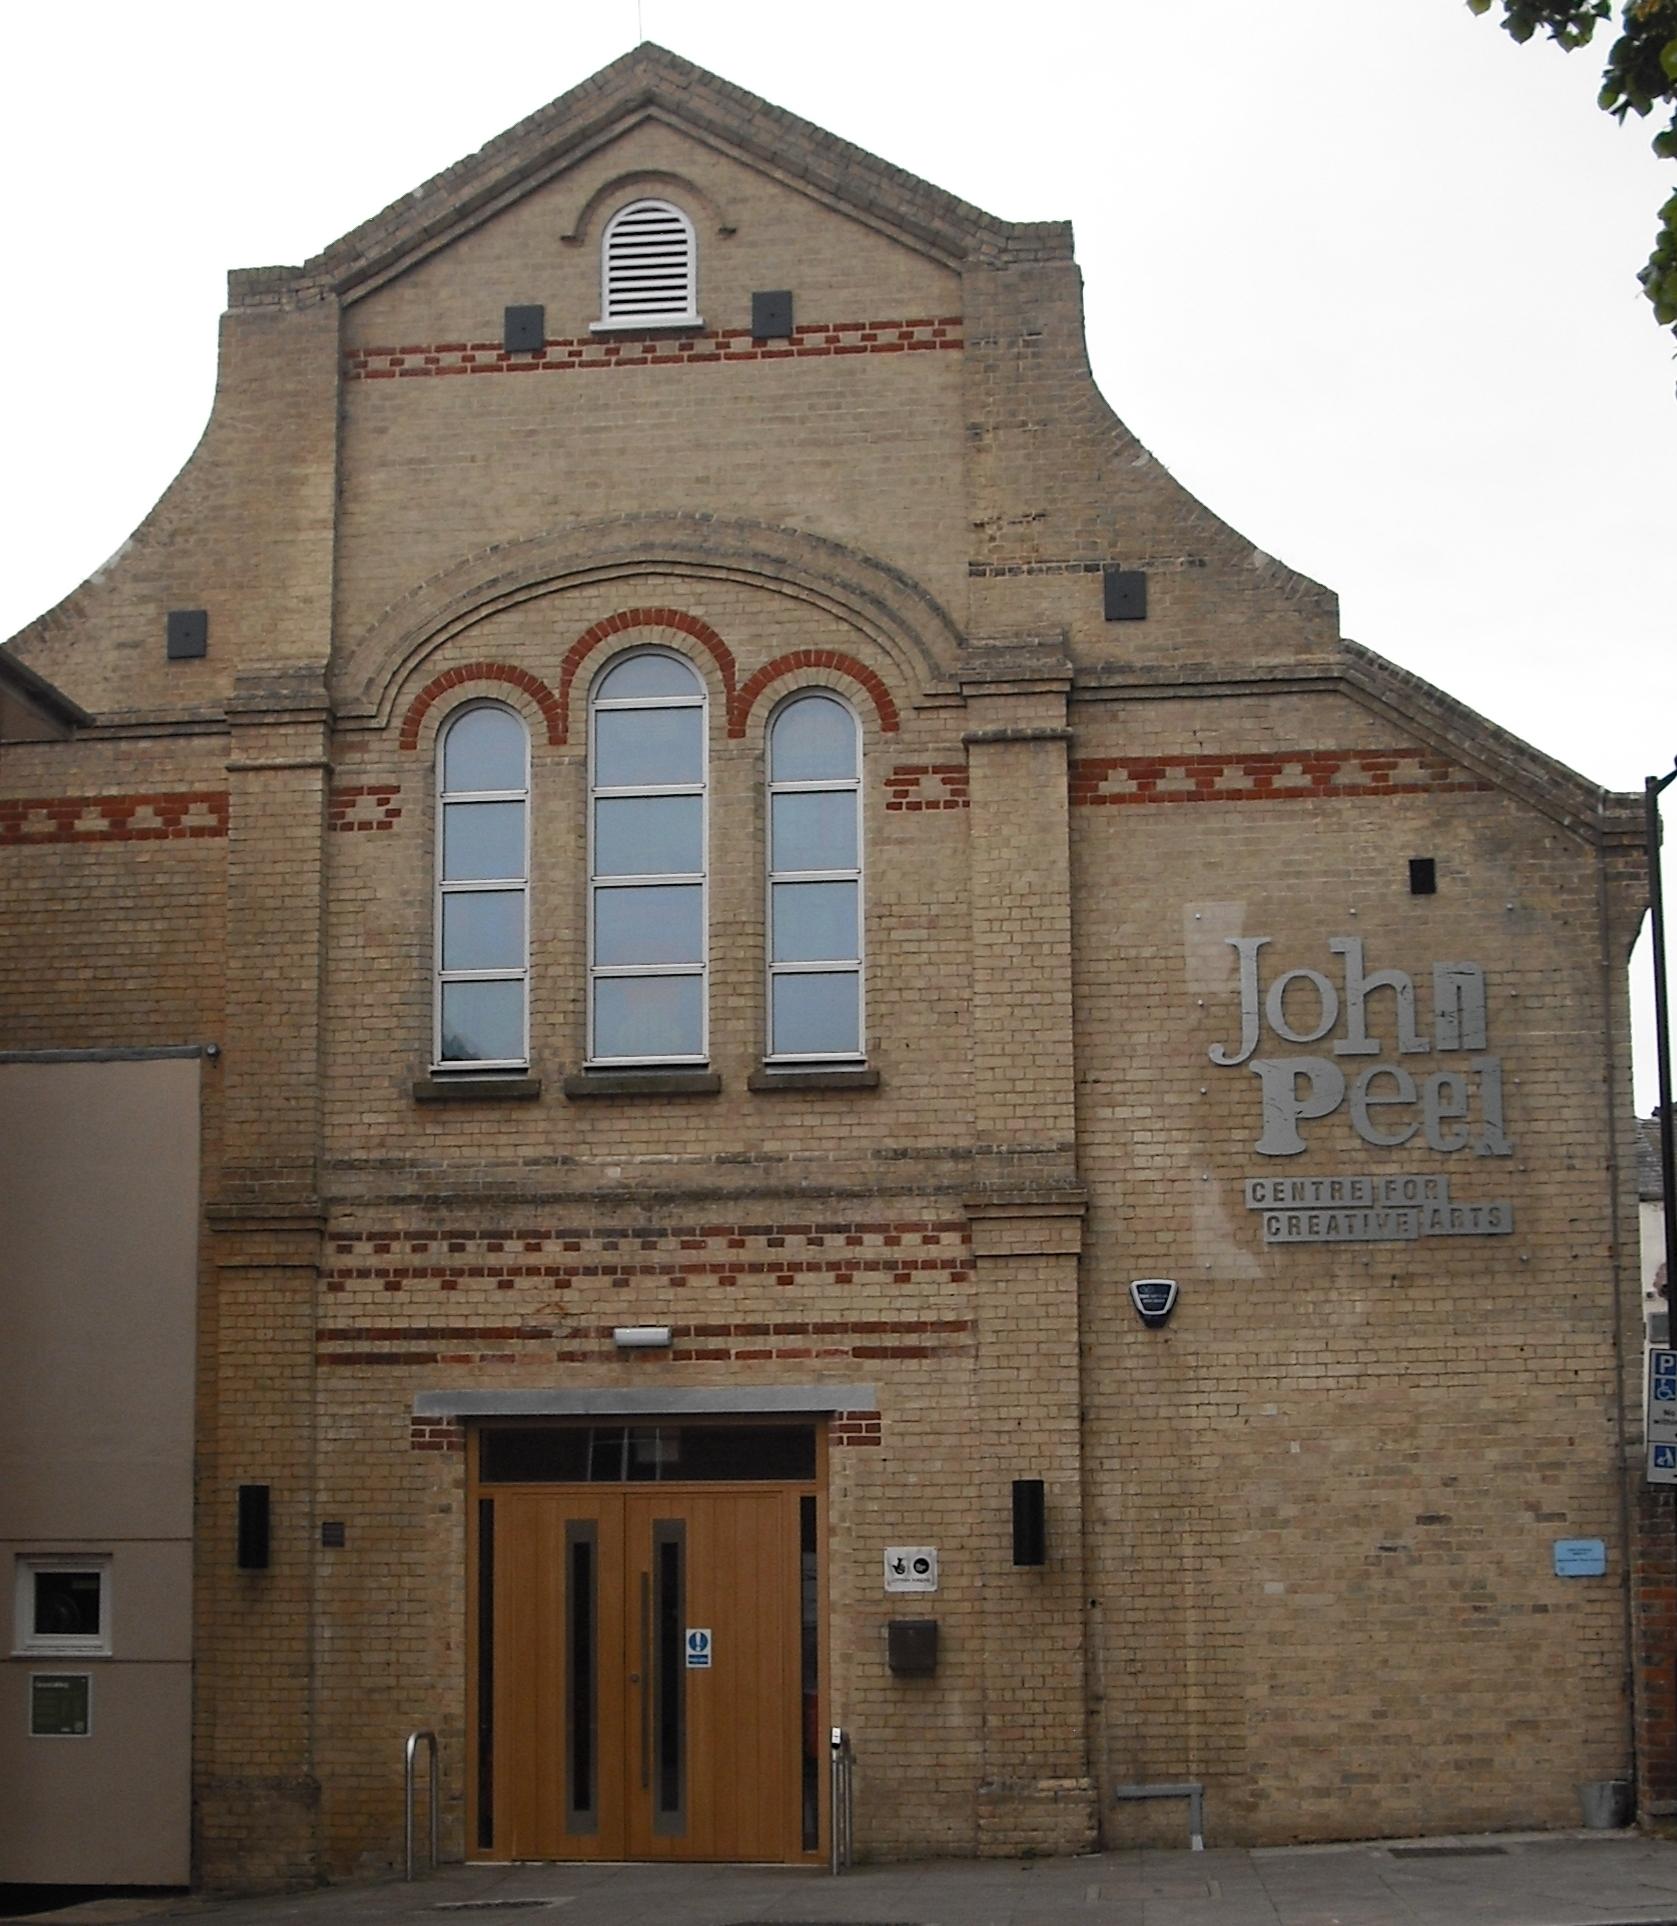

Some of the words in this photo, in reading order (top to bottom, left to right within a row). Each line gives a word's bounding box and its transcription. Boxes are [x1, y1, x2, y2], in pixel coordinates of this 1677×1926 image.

[1208, 937, 1487, 1066] John
[1249, 1055, 1514, 1157] Peel
[1252, 1178, 1366, 1202] CENTRE
[1384, 1178, 1440, 1201] FOR
[1266, 1211, 1410, 1236] CREATIVE
[1429, 1205, 1503, 1230] ARTS
[1660, 1355, 1675, 1374] P
